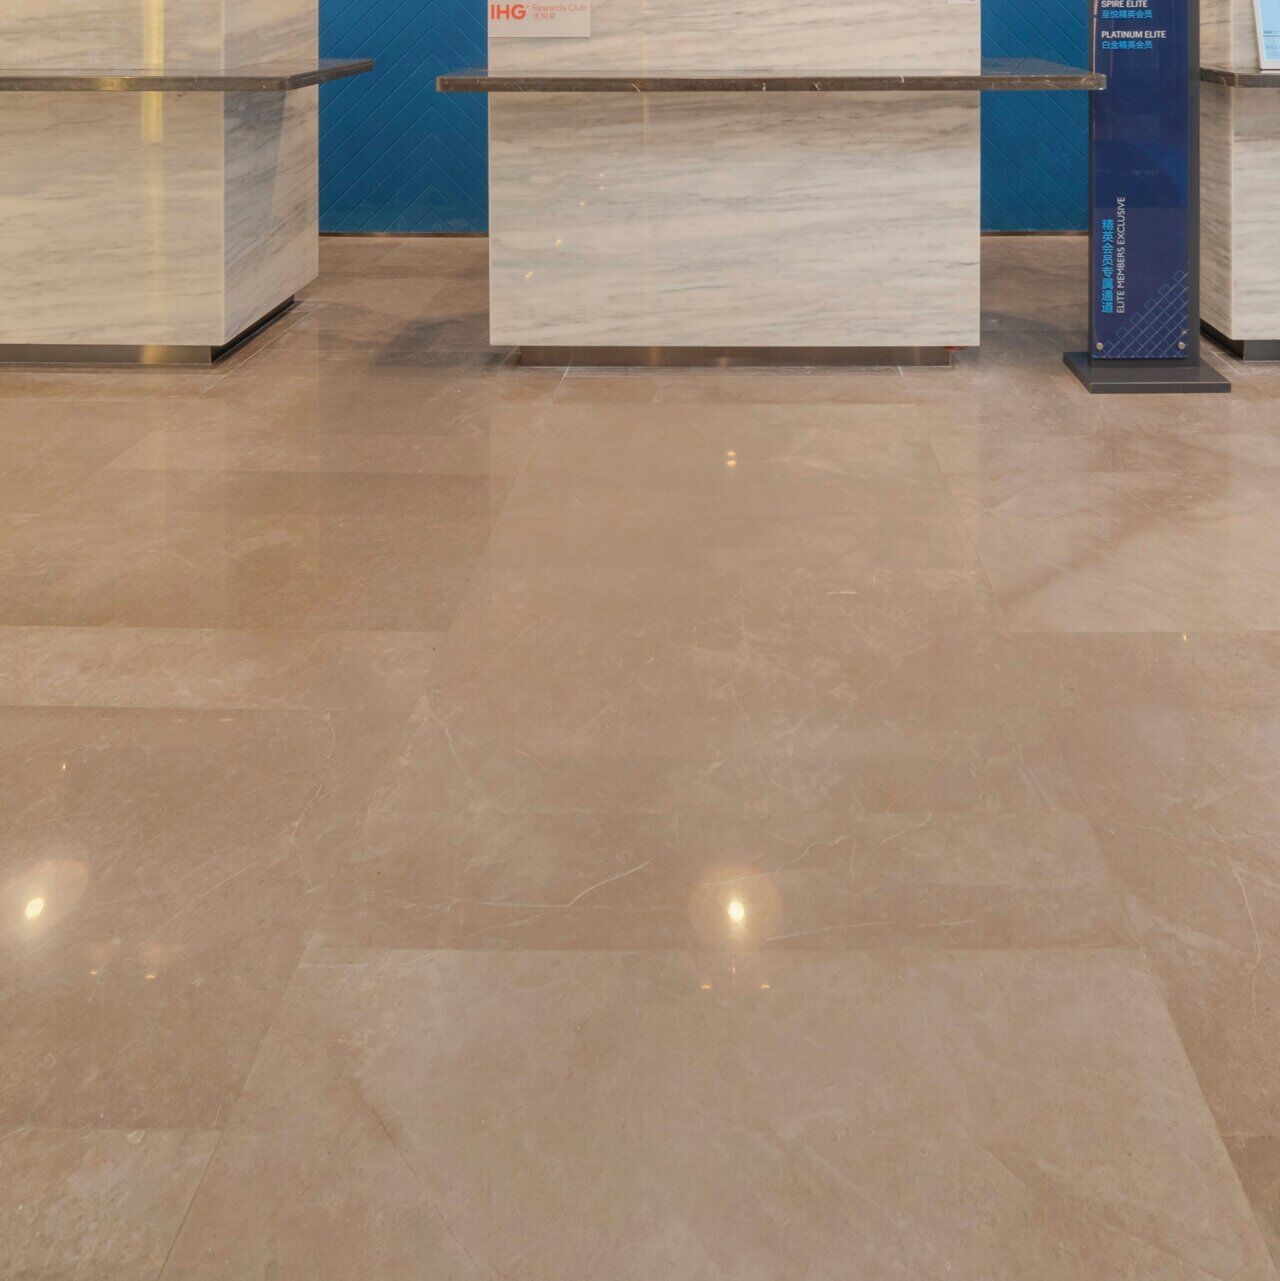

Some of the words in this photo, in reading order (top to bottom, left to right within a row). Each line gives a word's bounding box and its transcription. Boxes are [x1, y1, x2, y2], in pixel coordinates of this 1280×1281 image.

[490, 4, 526, 20] IHG
[532, 3, 567, 12] Rewards
[568, 3, 588, 12] Club
[1101, 0, 1124, 8] SPIRE
[1126, 0, 1148, 8] ELITE
[1101, 30, 1142, 39] PLATINUM
[1144, 30, 1167, 39] ELITE
[1101, 40, 1153, 50] 白金精英会员
[1116, 197, 1126, 245] EXCLUSIVE
[1102, 219, 1114, 314] 精英会员专属通道
[1116, 247, 1126, 289] MEMBERS
[1116, 290, 1126, 314] ELITE
